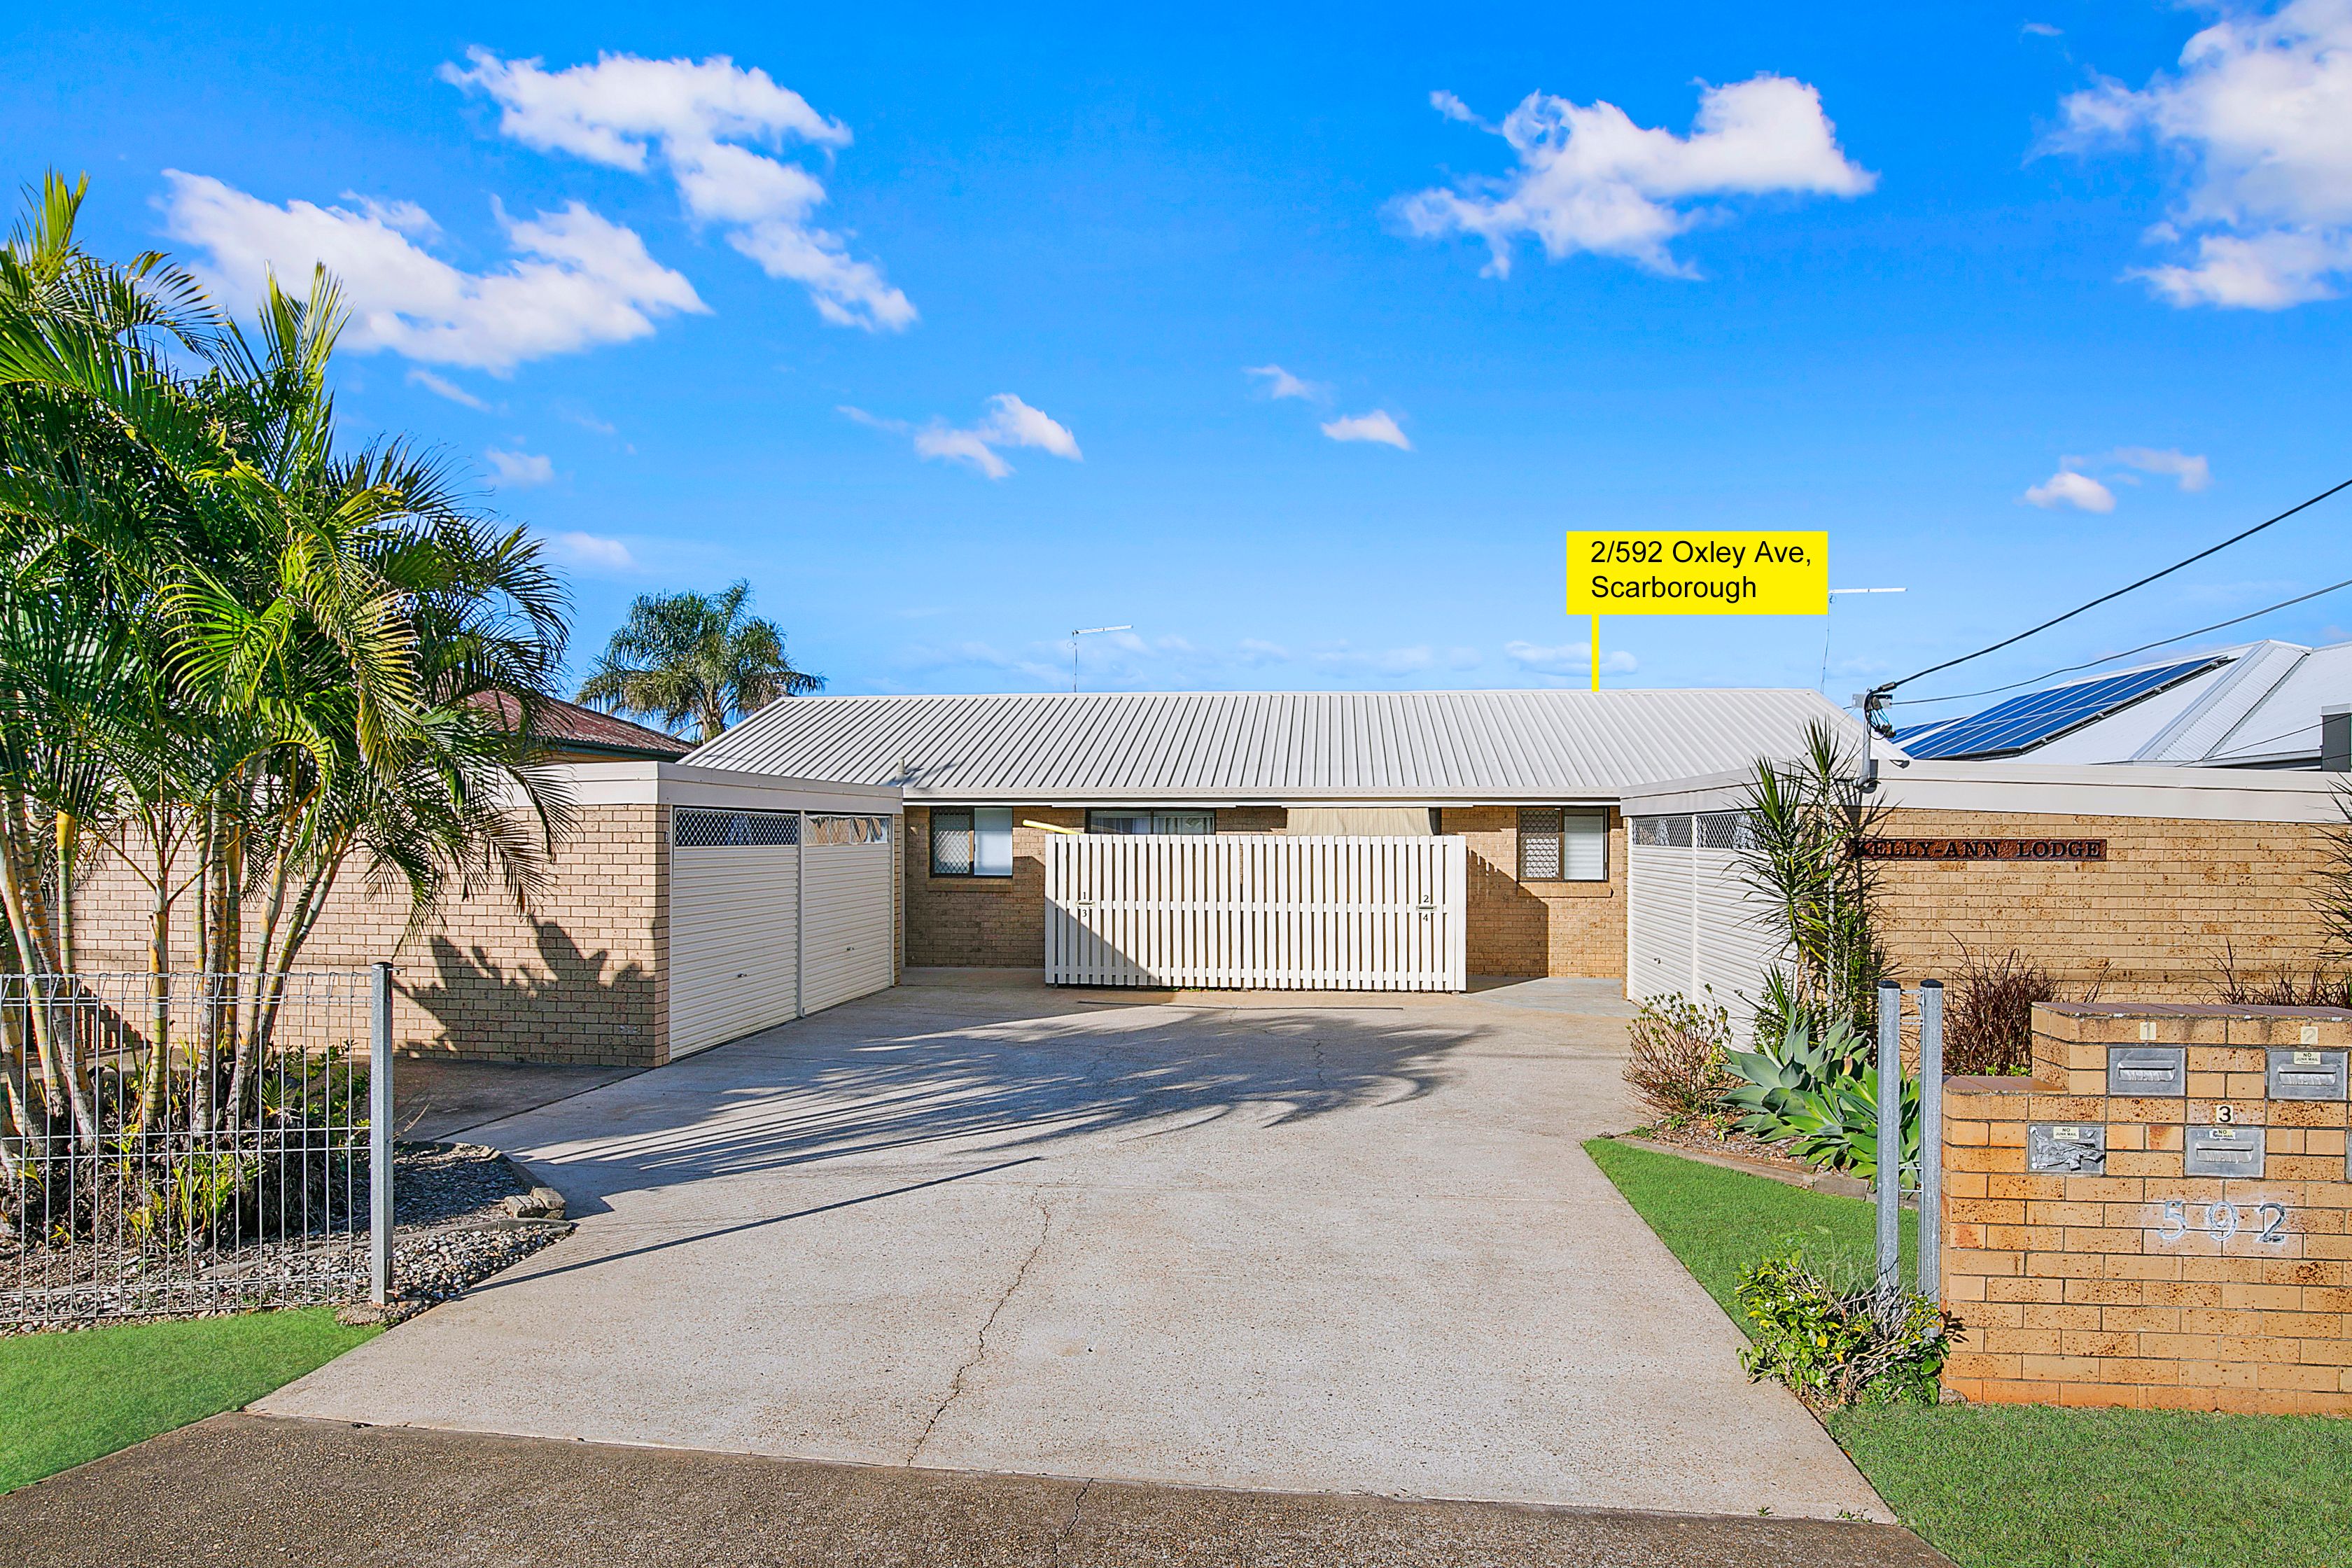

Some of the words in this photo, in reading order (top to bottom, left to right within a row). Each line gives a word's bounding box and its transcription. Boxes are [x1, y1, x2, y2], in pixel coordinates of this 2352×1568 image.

[1855, 841, 2001, 858] KELLY-ANN
[2017, 841, 2100, 858] LODGE
[1423, 895, 1429, 903] 2
[1082, 909, 1087, 918] 3
[1422, 913, 1429, 922] 4
[2302, 1028, 2316, 1043] 2
[2219, 1106, 2231, 1122] 3
[2158, 1200, 2286, 1243] 592
